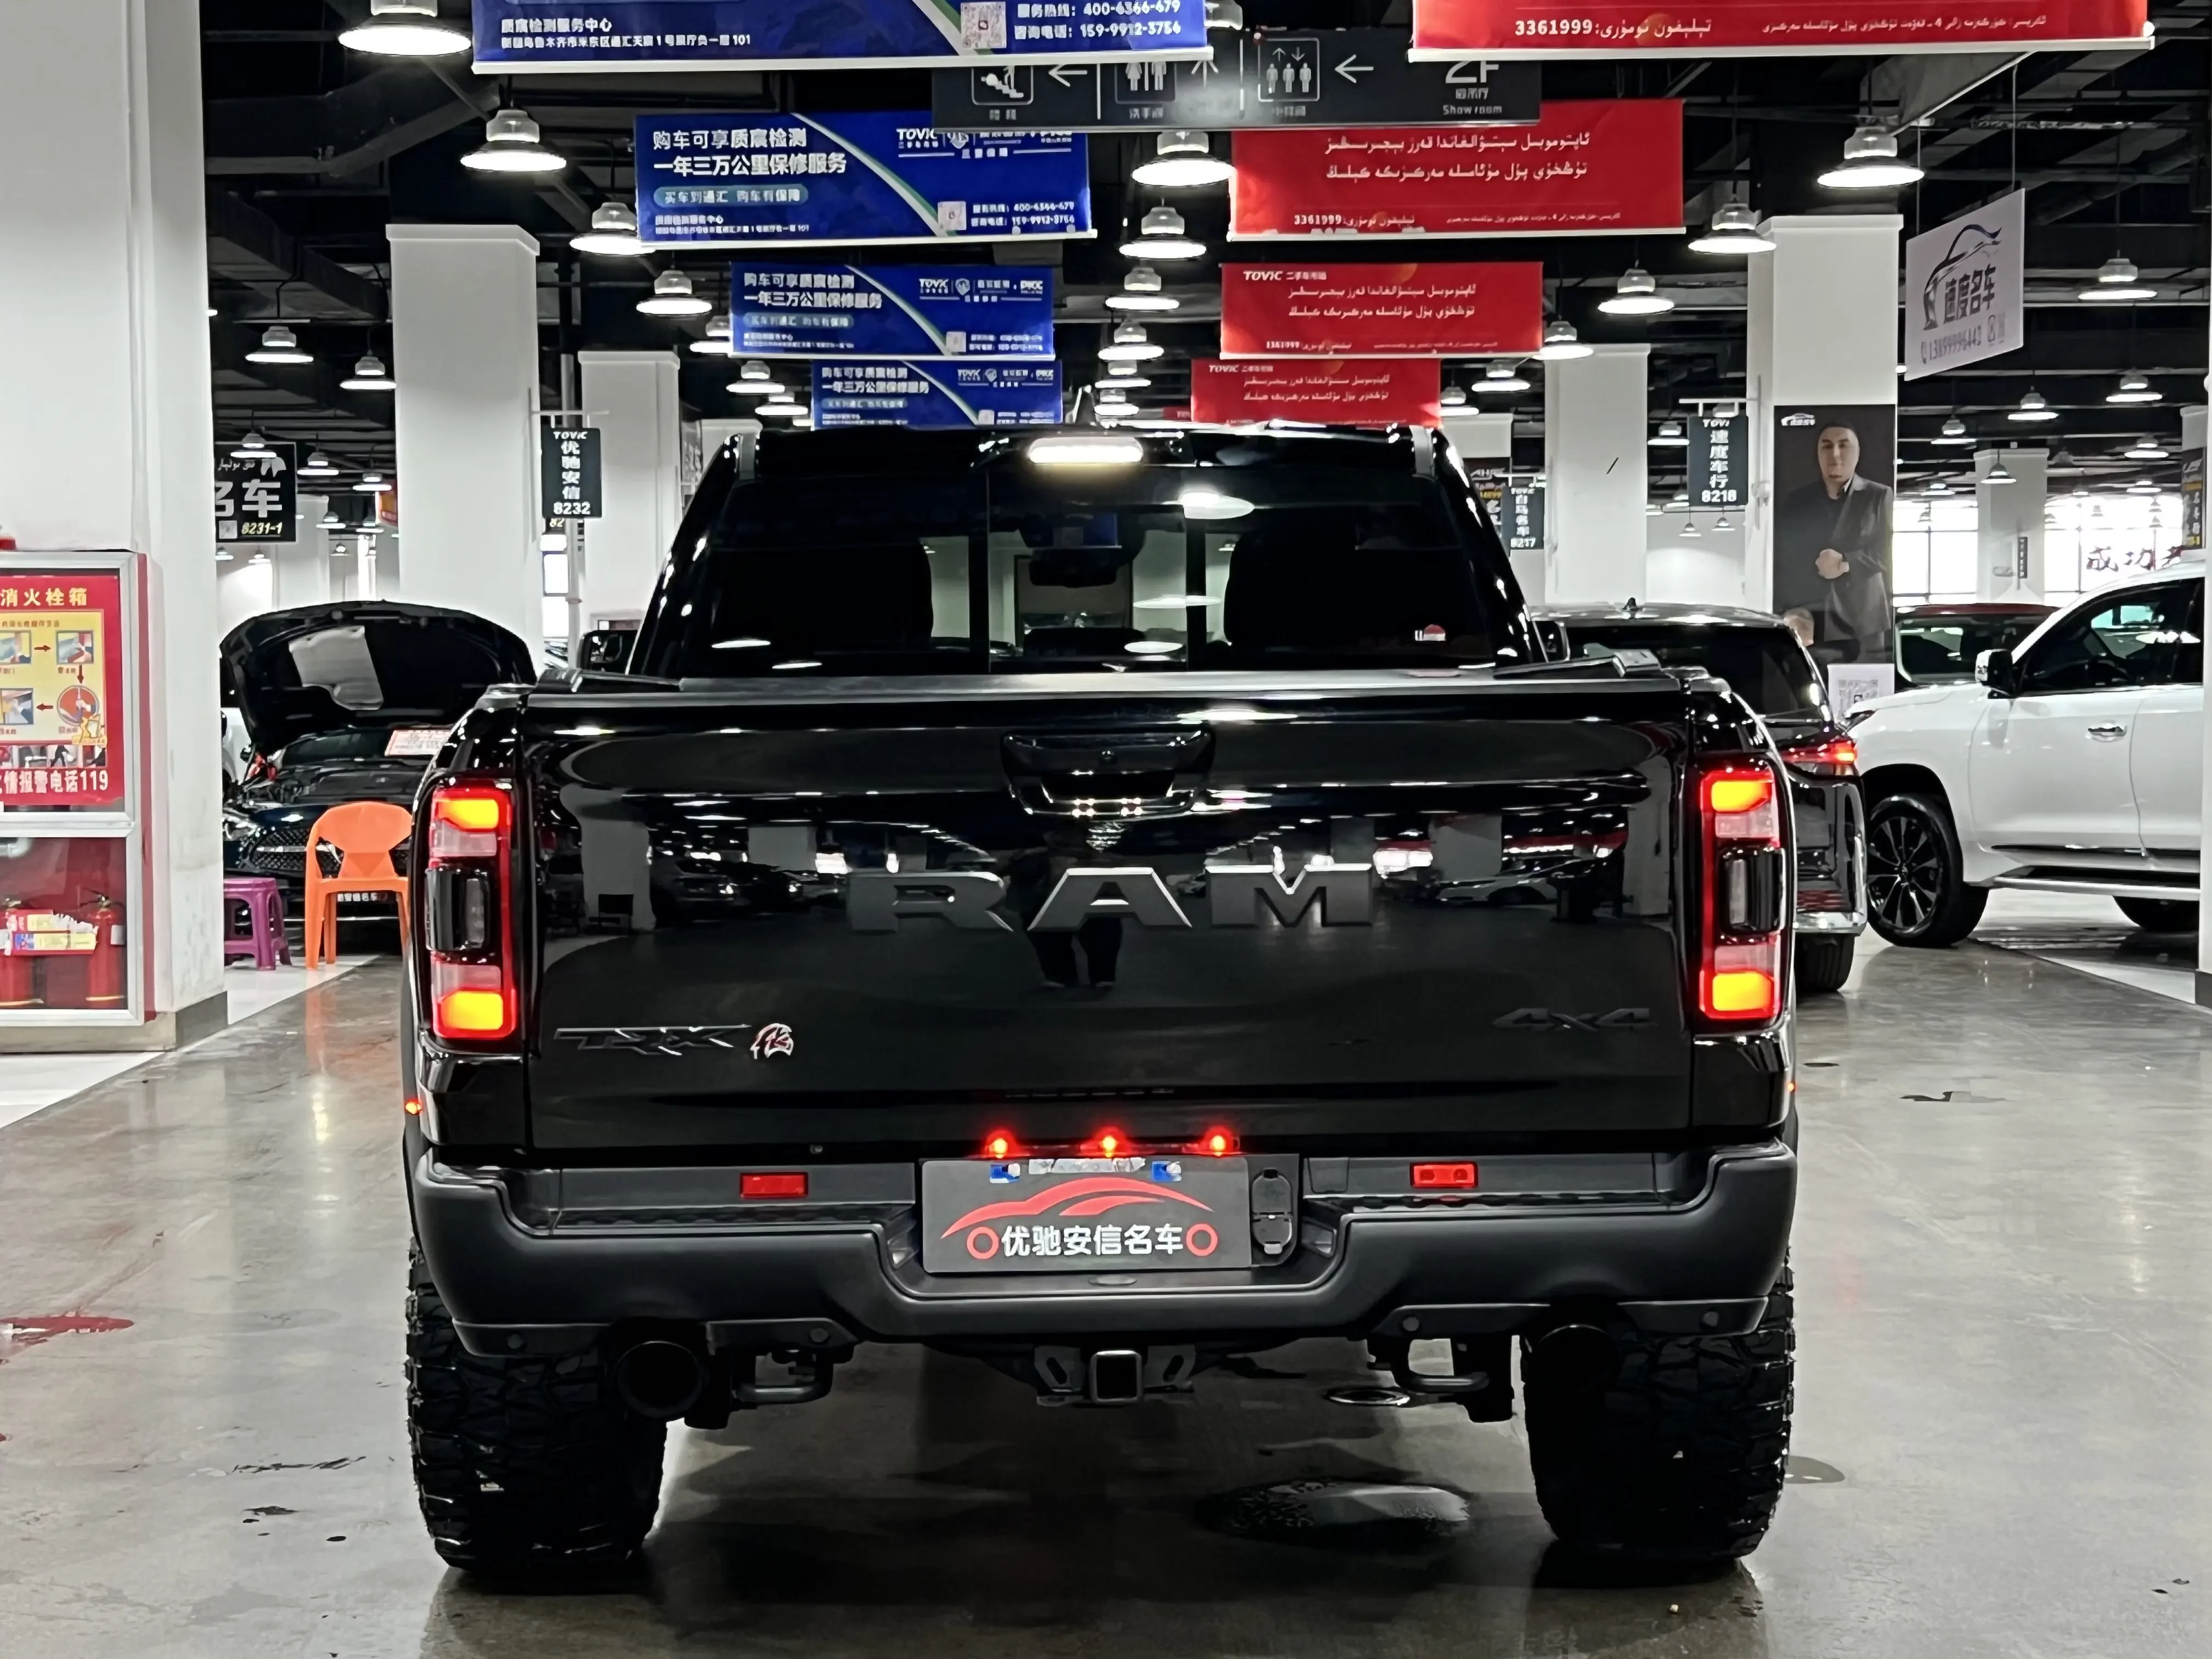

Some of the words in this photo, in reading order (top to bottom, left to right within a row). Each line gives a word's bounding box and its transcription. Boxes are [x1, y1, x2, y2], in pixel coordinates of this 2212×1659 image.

[1515, 19, 1593, 36] 3361999
[654, 152, 847, 177] 一年三万公里保修服务
[1244, 271, 1283, 281] TOVIC
[553, 501, 591, 515] 8232
[241, 522, 283, 534] 8231-1
[0, 588, 87, 607] 消火栓箱
[0, 770, 108, 794] 情报警电话119
[848, 865, 1373, 933] RAM
[1002, 1223, 1184, 1257] 优驰安信名车
